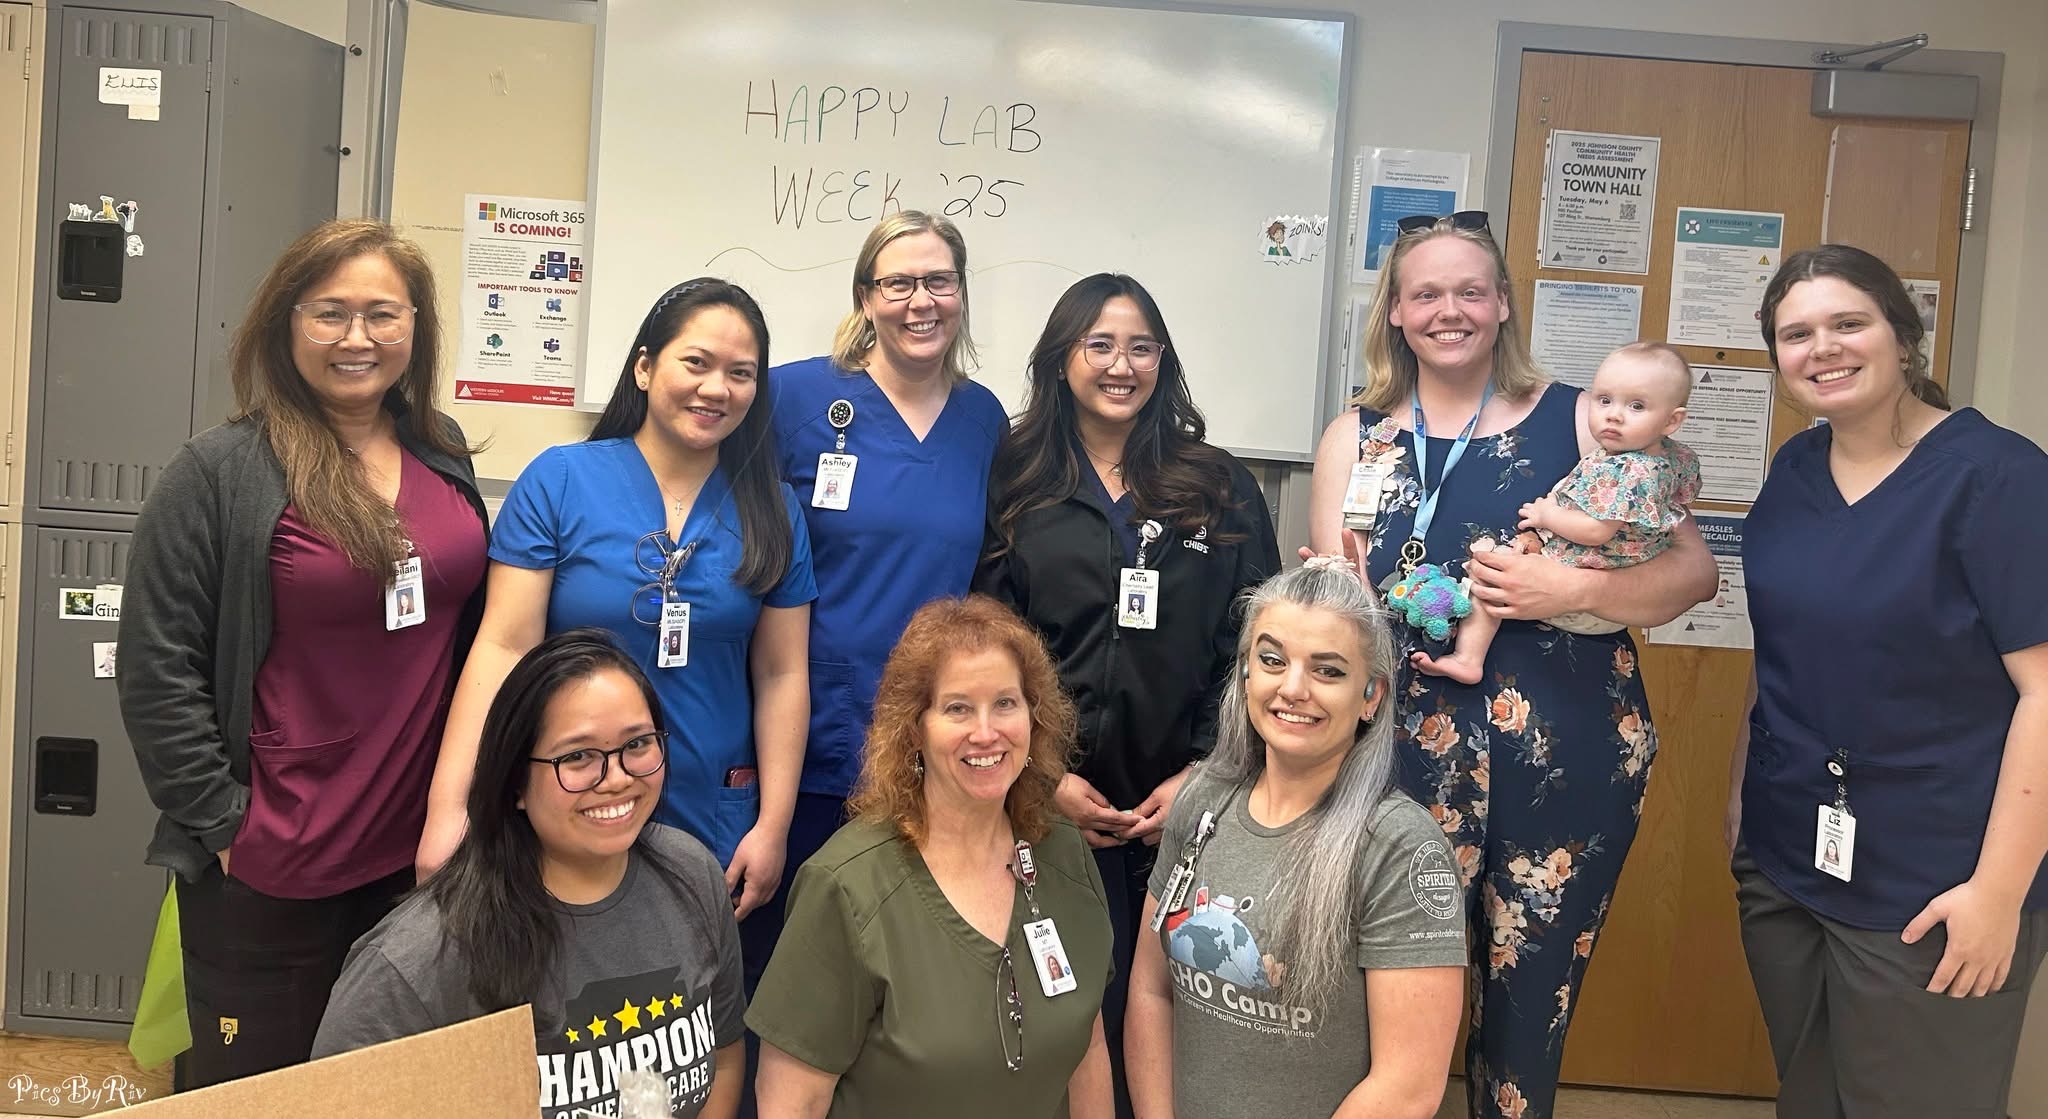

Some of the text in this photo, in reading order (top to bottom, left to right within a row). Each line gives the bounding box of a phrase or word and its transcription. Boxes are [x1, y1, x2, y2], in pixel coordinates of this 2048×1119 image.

[105, 74, 158, 89] ELLIS
[745, 79, 1041, 153] HAPPY LAB
[1576, 148, 1613, 156] COMMUNITY
[1597, 155, 1633, 163] ASSESSMENT
[1562, 162, 1647, 180] COMMUNITY
[1563, 178, 1642, 196] TOWN HALL
[773, 165, 1025, 230] WEEK '25
[1560, 196, 1587, 204] Tuesday,
[1589, 198, 1603, 206] May
[500, 207, 585, 224] Microsoft 365
[494, 222, 571, 238] IS COMING!
[1289, 221, 1325, 239] ZOINKS!
[478, 283, 517, 291] IMPORTANT
[520, 285, 541, 293] TOOLS
[1540, 282, 1573, 290] BRINGING
[1574, 283, 1609, 292] BENEFITS
[821, 458, 851, 468] Ashley
[1697, 524, 1734, 534] MEASLES
[1701, 532, 1743, 542] RECAUTIO
[394, 563, 418, 576] eilani
[1129, 574, 1147, 583] Aira
[95, 603, 120, 617] Gin
[667, 608, 687, 617] Venus
[1828, 814, 1841, 827] Liz
[1417, 873, 1456, 888] SPIRITED
[1034, 927, 1051, 939] Julie
[1168, 958, 1312, 1030] CHO Camp
[1205, 1007, 1213, 1015] in
[1212, 1009, 1252, 1029] Healthcare
[1253, 1022, 1315, 1039] Opportunities
